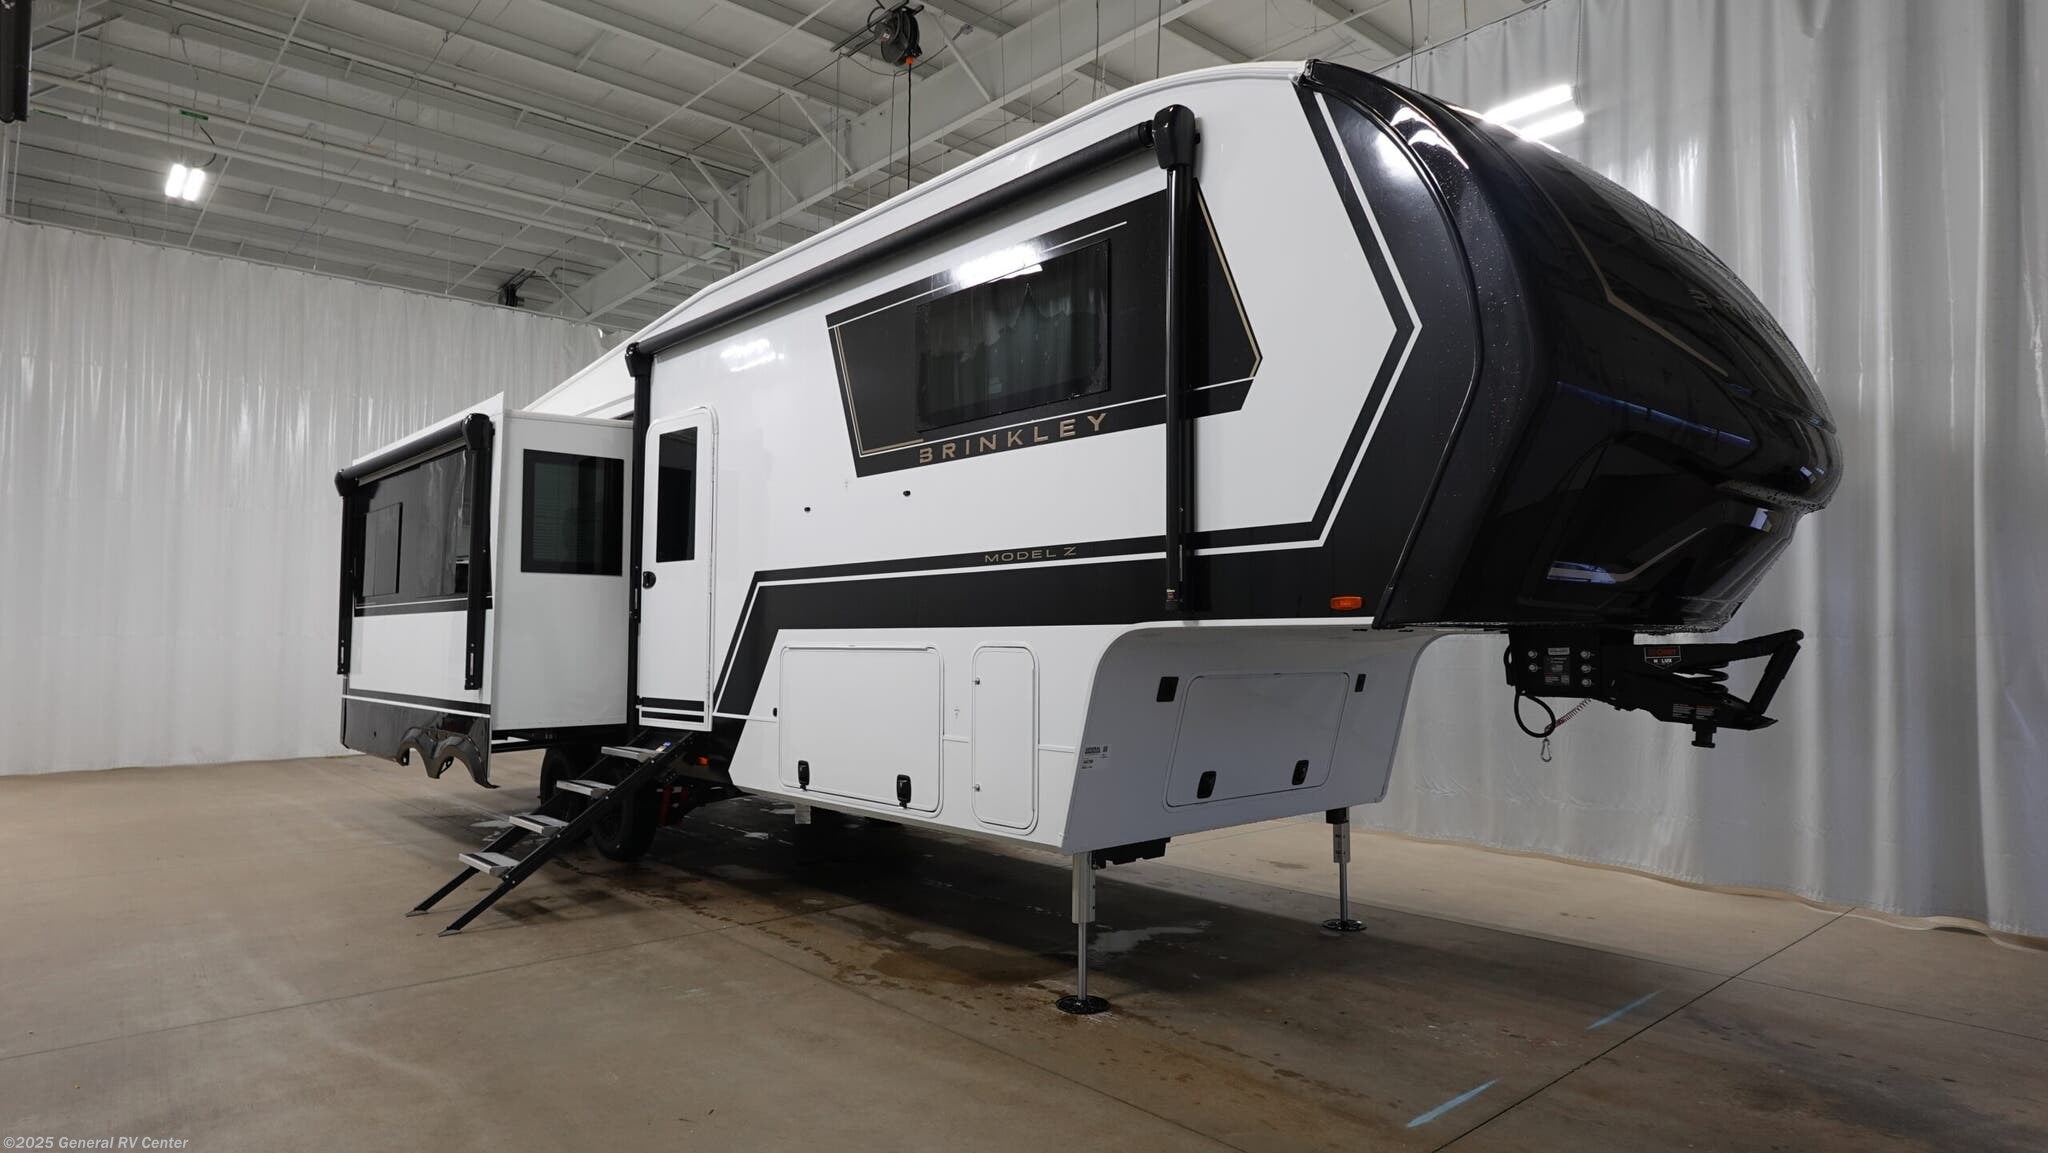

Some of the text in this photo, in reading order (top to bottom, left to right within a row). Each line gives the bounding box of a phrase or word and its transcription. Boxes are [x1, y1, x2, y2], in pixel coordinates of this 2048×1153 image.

[919, 412, 1107, 464] BRINKLEY
[984, 546, 1077, 563] MODEL Z
